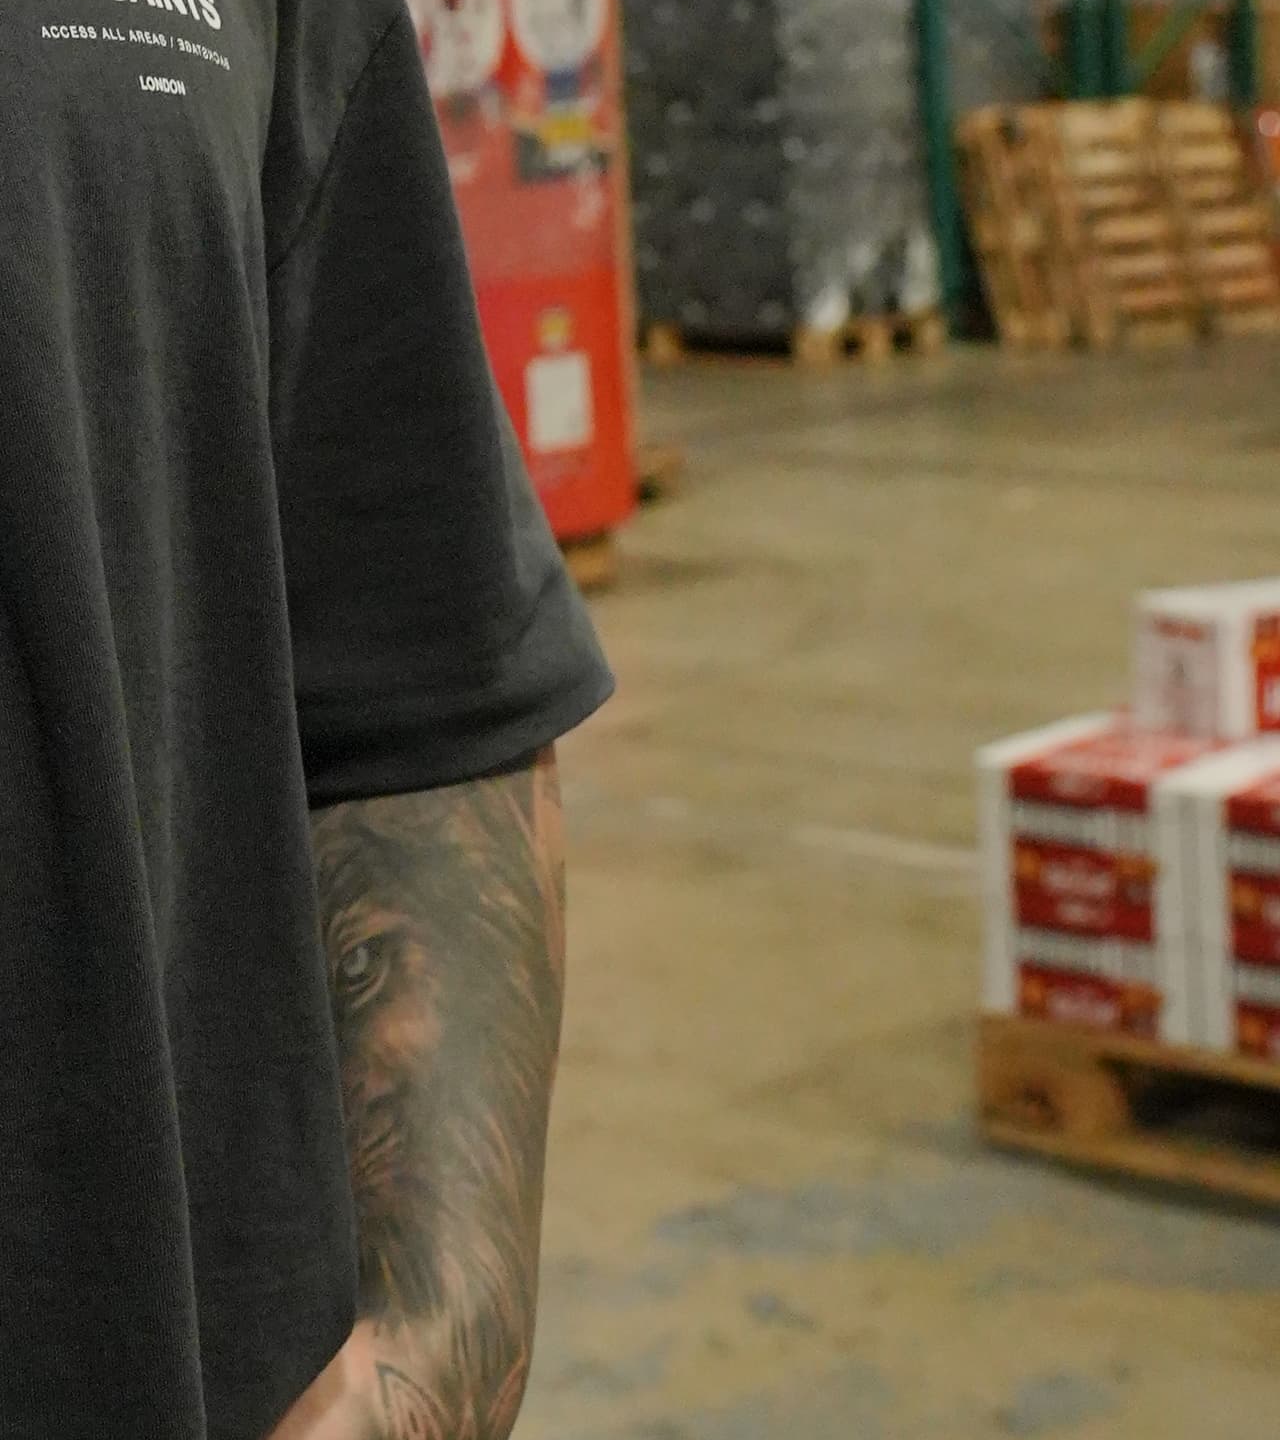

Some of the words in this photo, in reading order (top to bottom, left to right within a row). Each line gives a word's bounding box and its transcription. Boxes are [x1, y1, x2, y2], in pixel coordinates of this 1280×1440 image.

[41, 25, 97, 39] ACCESS
[101, 27, 126, 41] ALL
[129, 29, 167, 47] AREAS
[139, 75, 186, 96] LONDON
